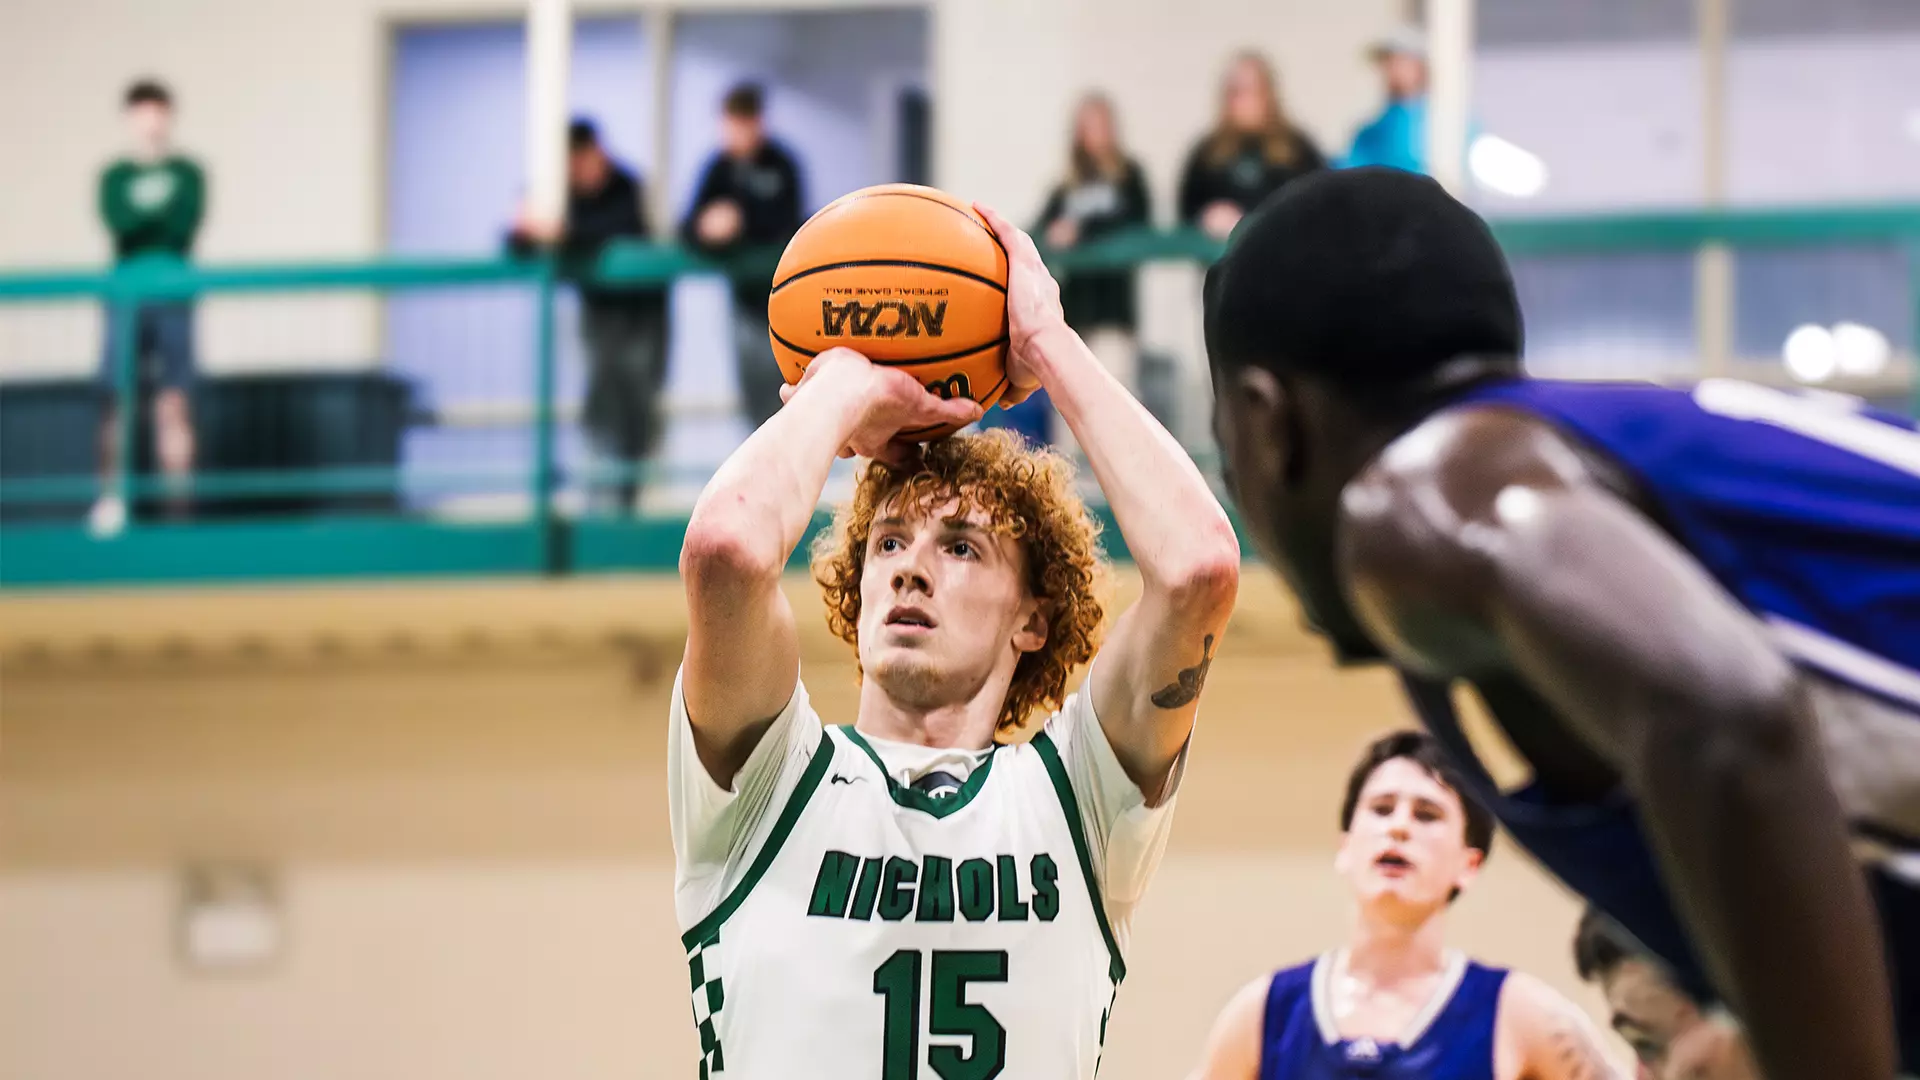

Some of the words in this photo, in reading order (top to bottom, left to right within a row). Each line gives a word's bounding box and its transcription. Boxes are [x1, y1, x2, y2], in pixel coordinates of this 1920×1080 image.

[823, 287, 852, 296] BALL
[855, 287, 892, 296] GAME
[895, 287, 949, 296] OFFICIAL
[822, 300, 948, 338] NCAA
[806, 850, 1060, 923] NICHOLS
[873, 949, 1008, 1080] 15
